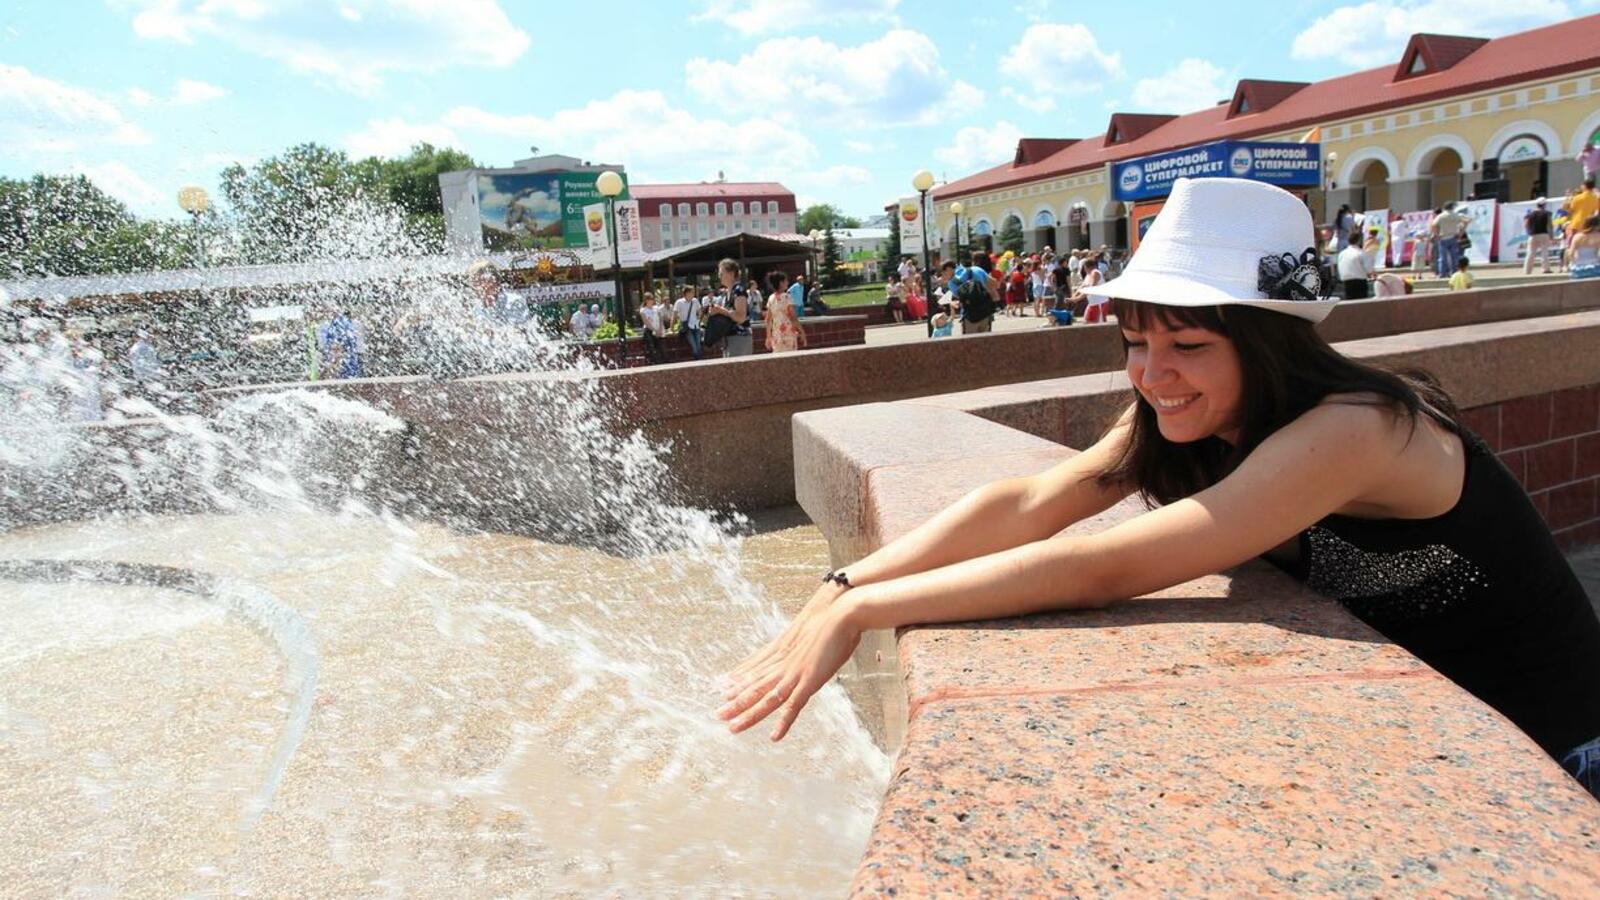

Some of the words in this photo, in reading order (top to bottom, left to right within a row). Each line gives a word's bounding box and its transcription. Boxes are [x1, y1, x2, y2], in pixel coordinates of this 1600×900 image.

[1254, 147, 1308, 159] ЦИФРОВОЙ
[1144, 150, 1209, 173] ЦИФРОВОЙ
[1254, 160, 1319, 170] СУПЕРМАРКЕТ
[1144, 161, 1223, 183] СУПЕРМАРКЕТ
[564, 181, 594, 190] Роуминг
[566, 203, 575, 214] 6
